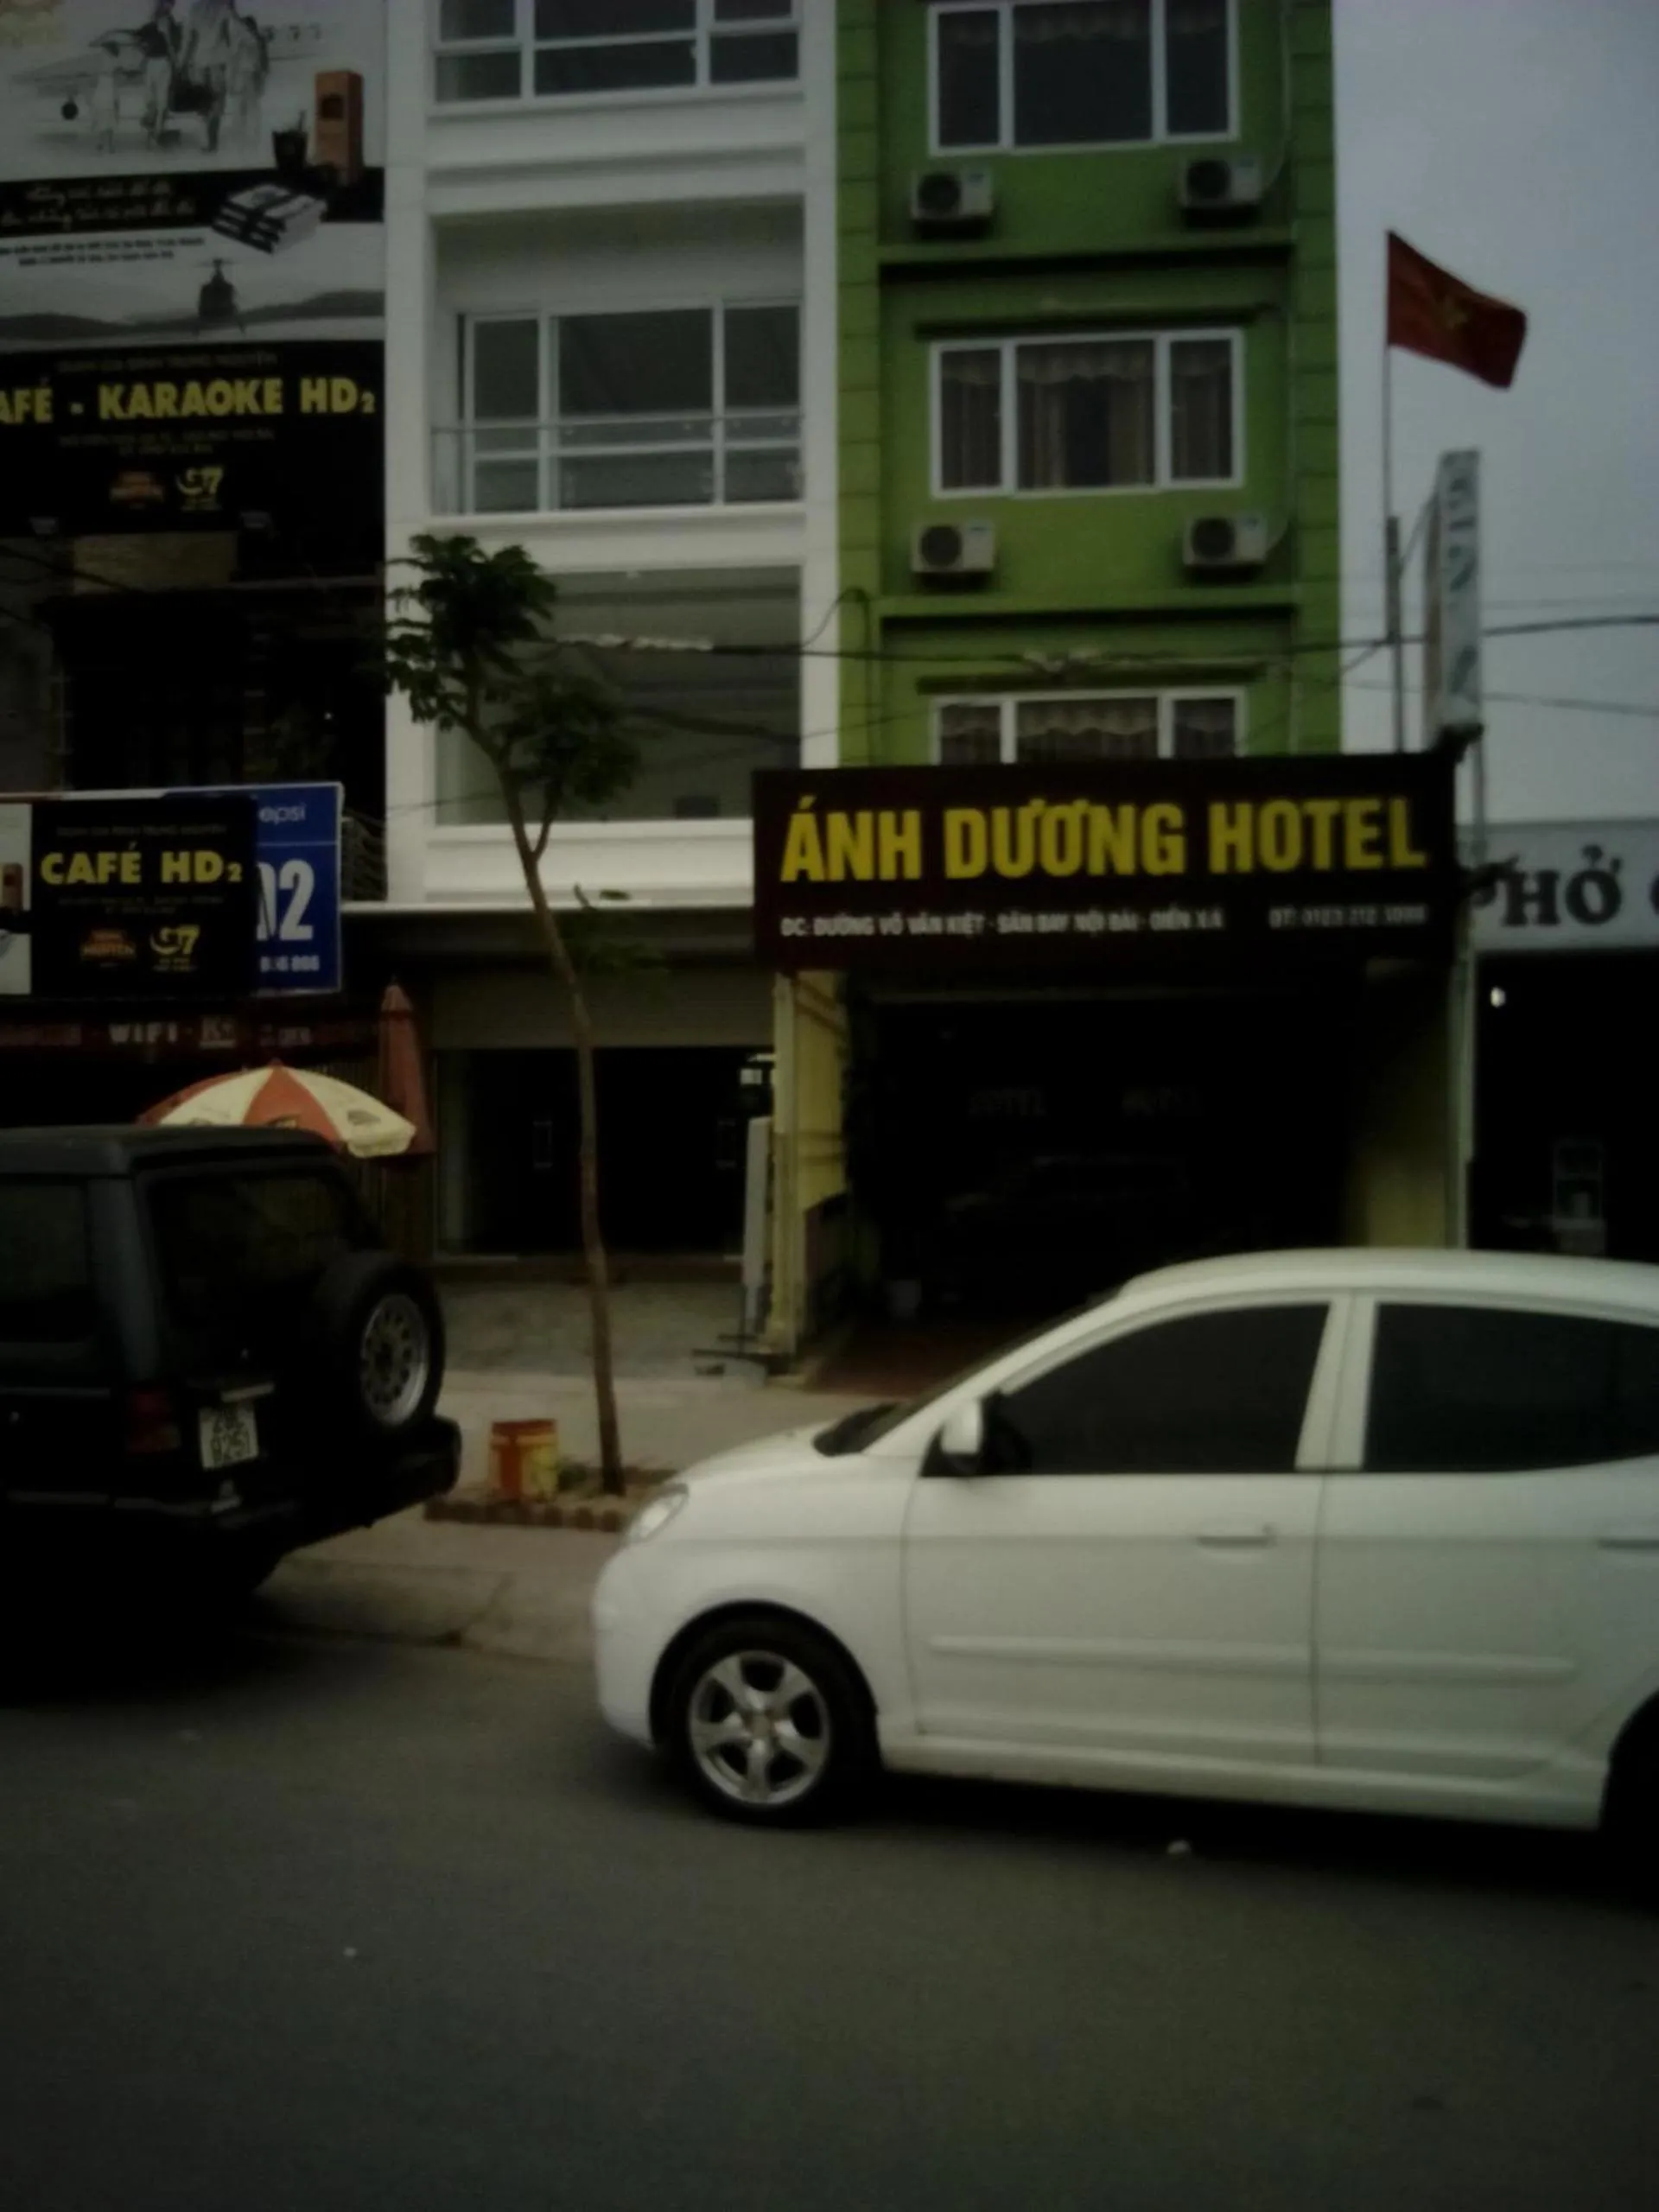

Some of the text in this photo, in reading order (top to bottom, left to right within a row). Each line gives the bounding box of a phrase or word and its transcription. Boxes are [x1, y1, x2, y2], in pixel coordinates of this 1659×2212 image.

[97, 377, 284, 421] KARAOKE
[780, 793, 1428, 882] ÁNH DƯƠNG HOTEL
[40, 841, 142, 886] CAFÉ
